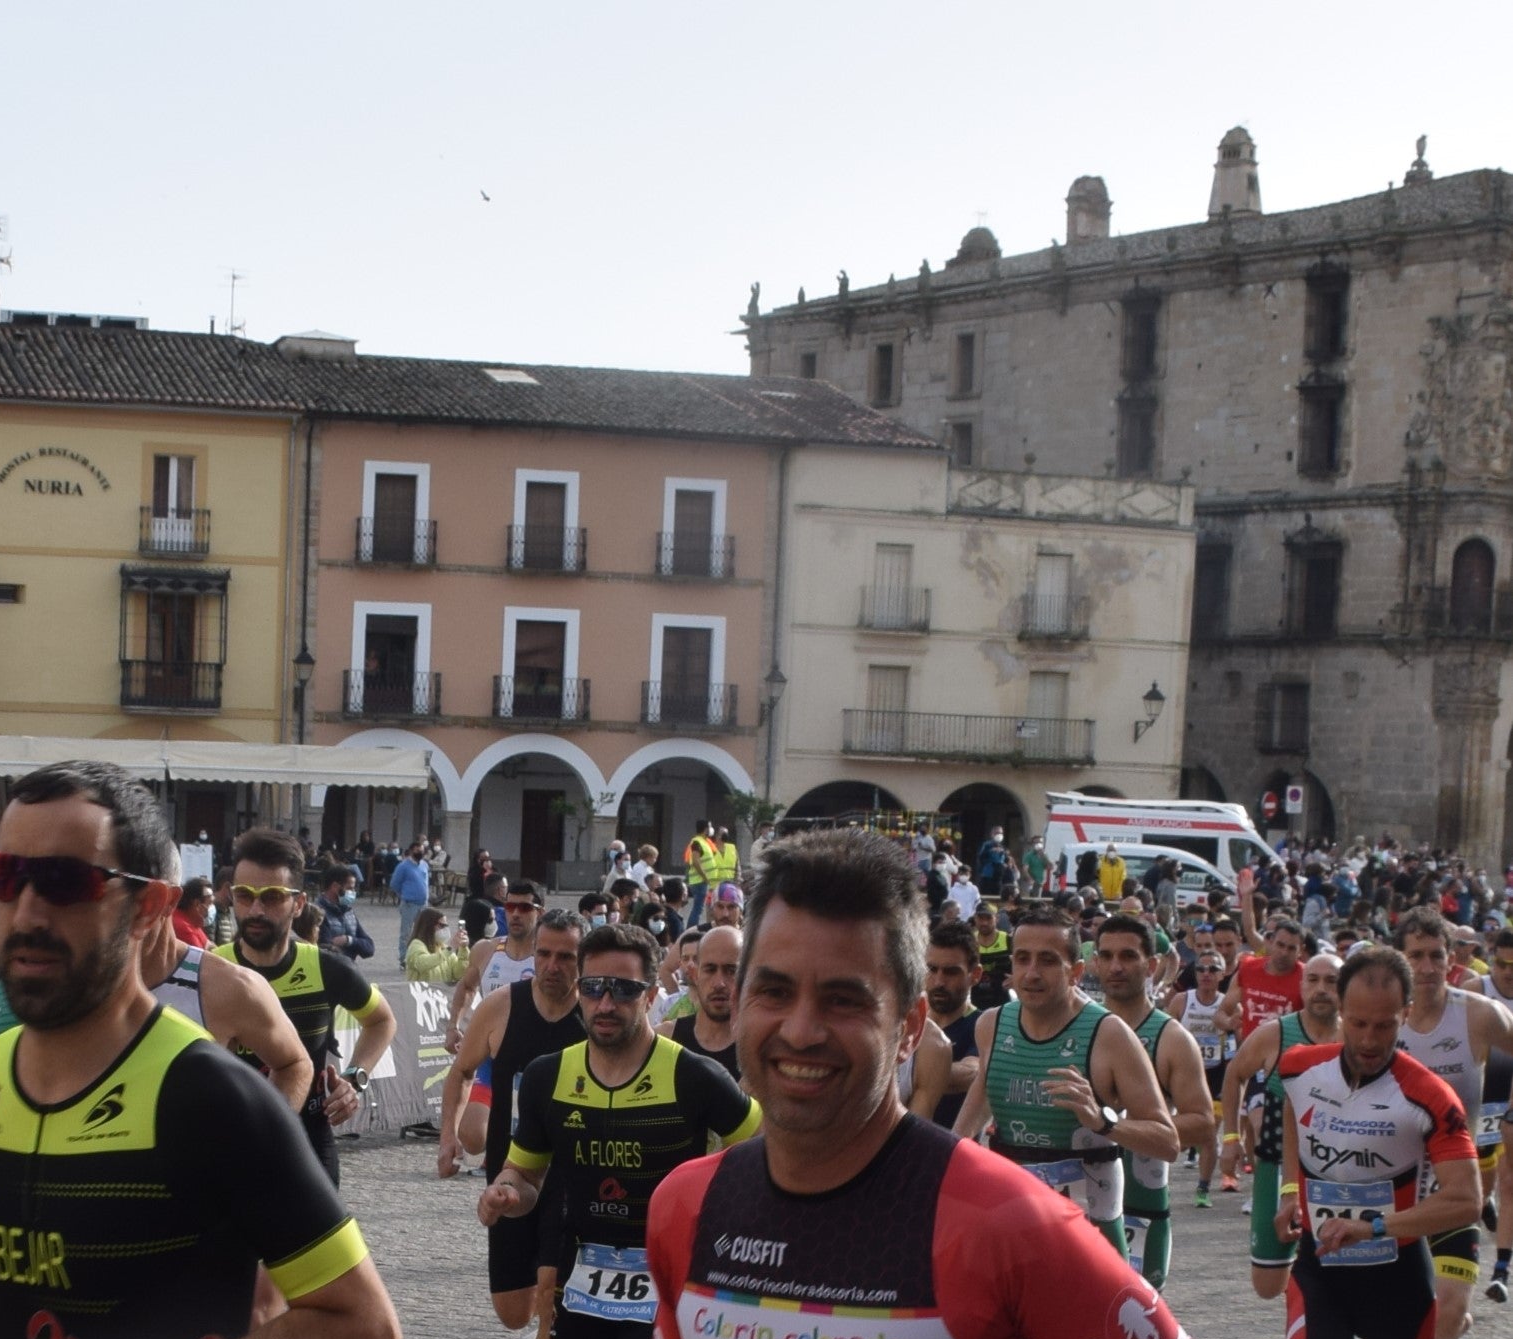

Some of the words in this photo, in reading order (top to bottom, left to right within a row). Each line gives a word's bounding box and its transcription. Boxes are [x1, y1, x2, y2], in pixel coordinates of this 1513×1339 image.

[38, 447, 112, 491] RESTAURANTE
[24, 479, 84, 497] NURIA
[1126, 818, 1193, 829] AMBULANCIA
[1328, 1123, 1396, 1137] DEPORTE
[1330, 1116, 1396, 1129] ZARAGOZA
[575, 1140, 587, 1165] A.
[590, 1140, 643, 1168] FLORES
[589, 1201, 629, 1216] area
[730, 1235, 788, 1268] CUSFIT
[588, 1269, 652, 1301] 146
